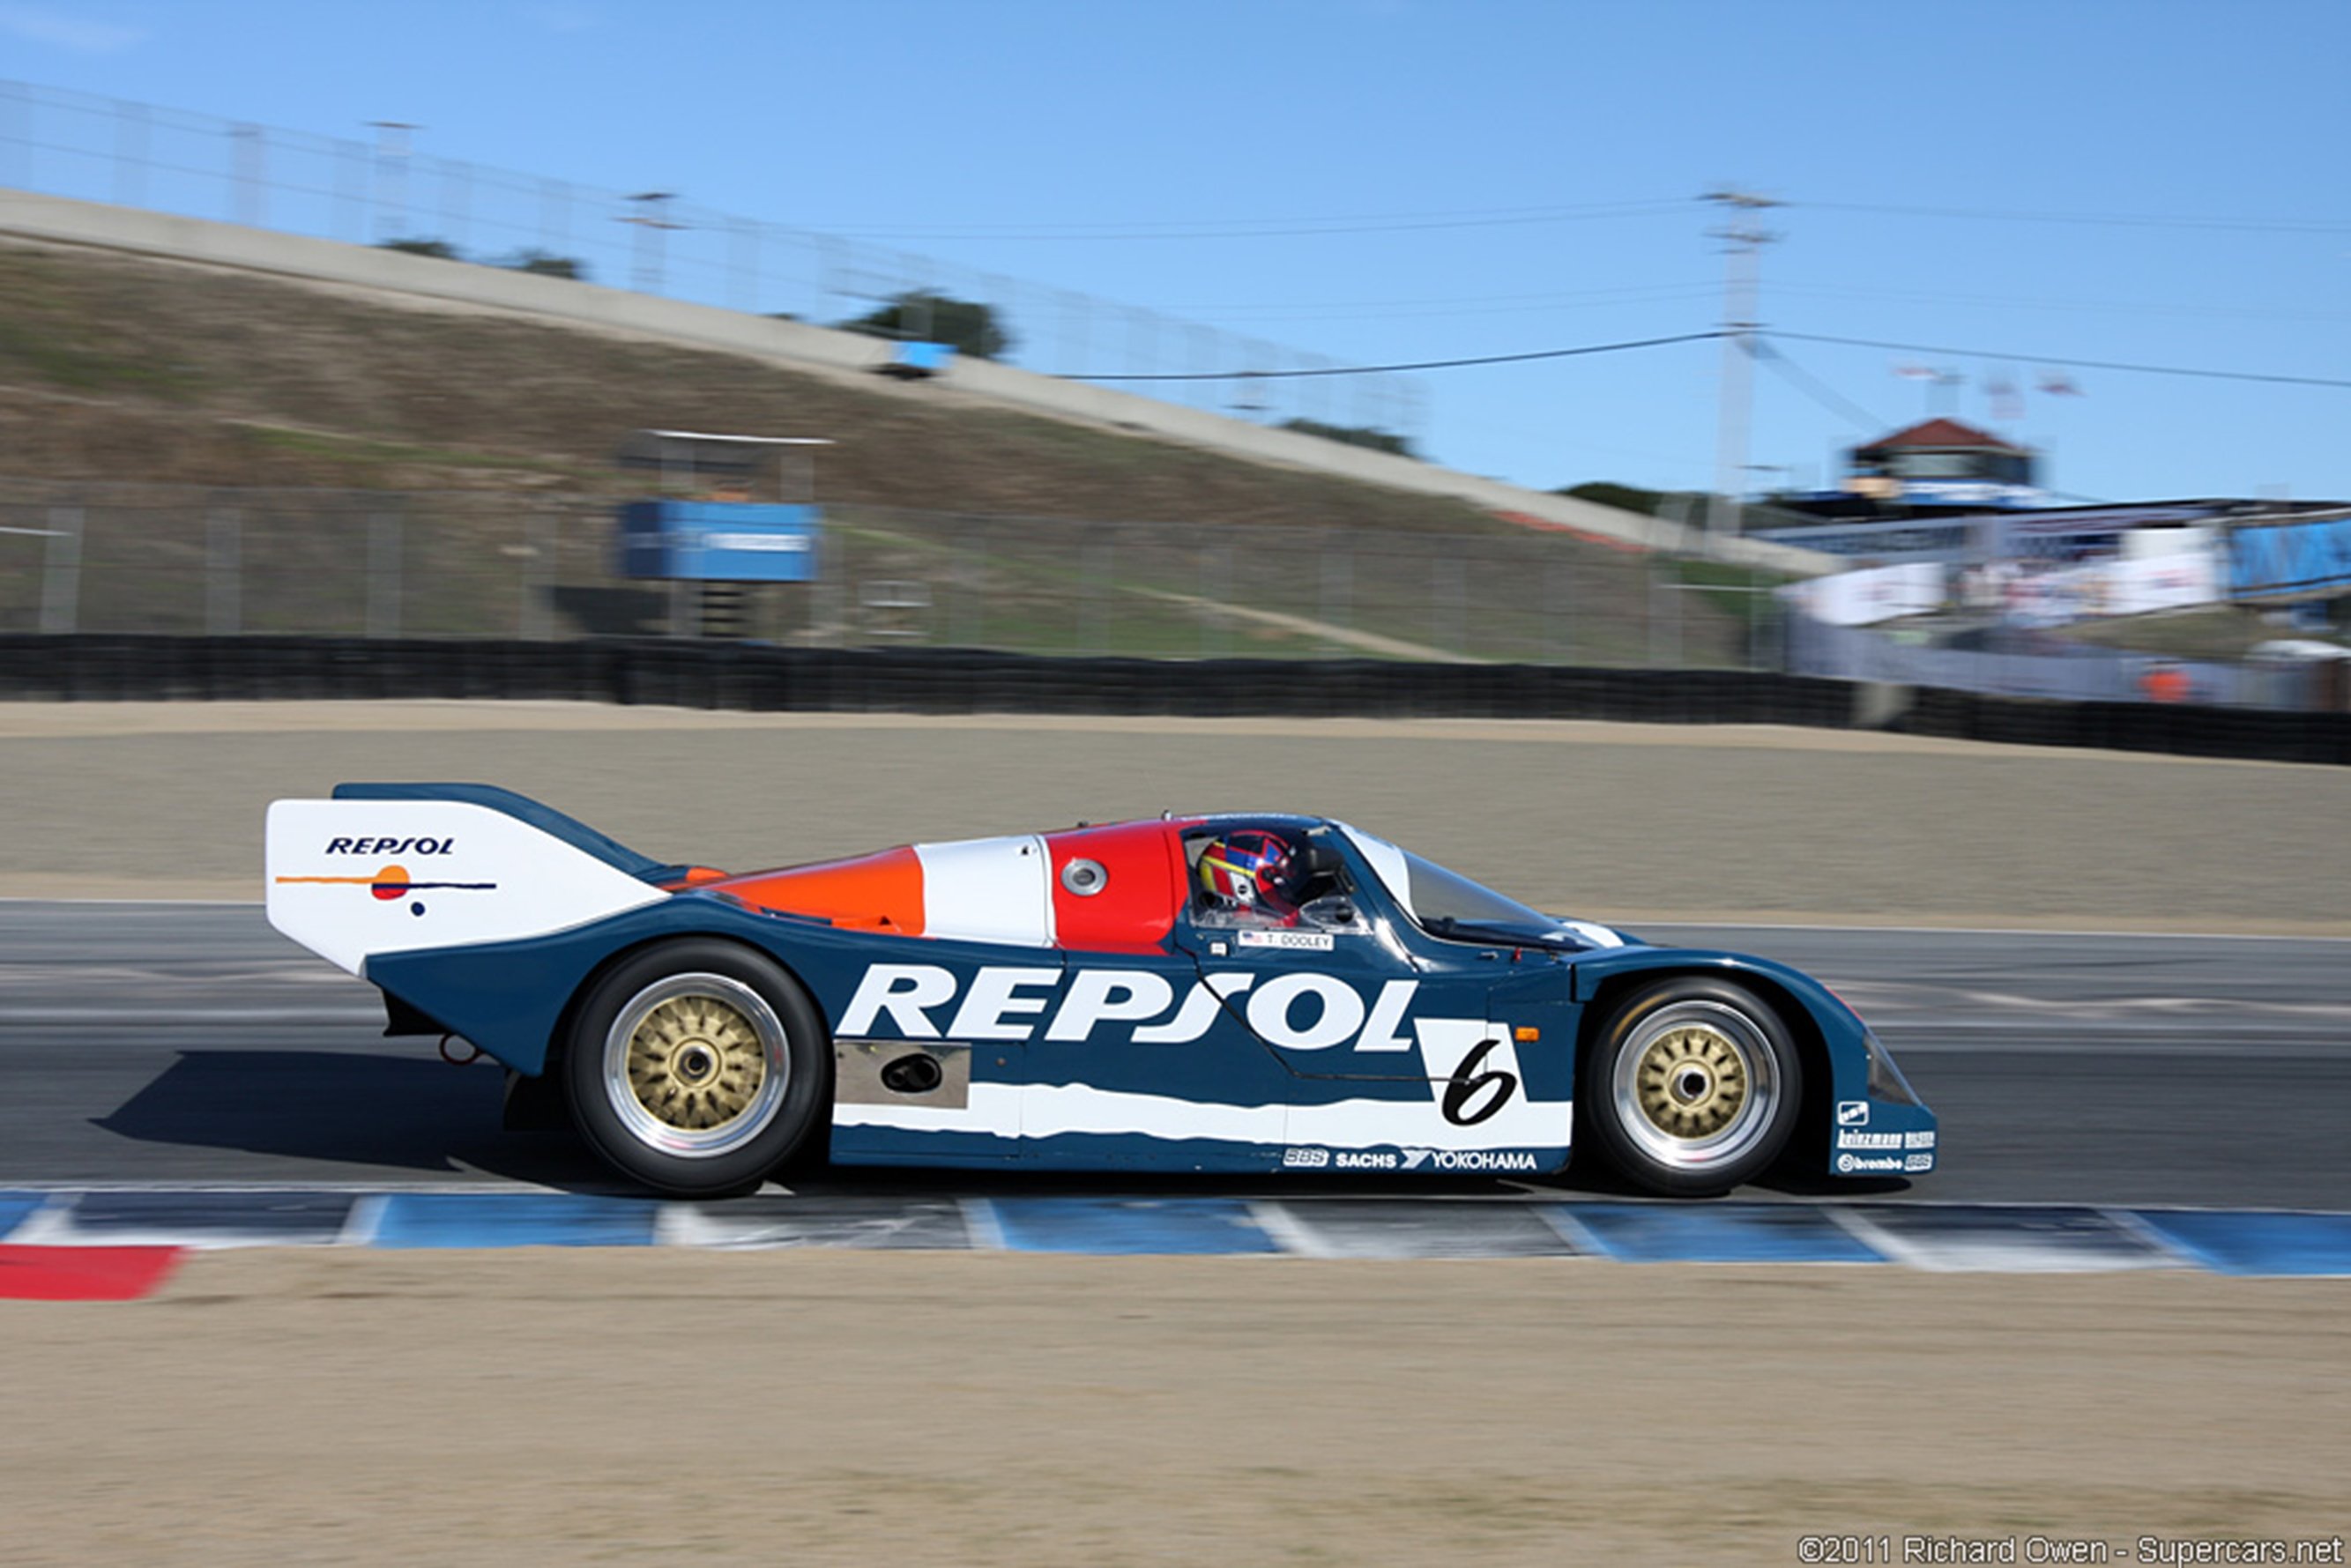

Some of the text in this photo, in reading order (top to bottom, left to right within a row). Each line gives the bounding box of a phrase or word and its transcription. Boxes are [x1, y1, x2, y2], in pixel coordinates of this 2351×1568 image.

[325, 837, 454, 855] REPSOL
[1281, 935, 1329, 947] DOOLEY
[835, 963, 1420, 1052] REPSOL
[1442, 1039, 1517, 1126] 6
[1335, 1153, 1397, 1169] SACHS
[1432, 1151, 1537, 1170] YOKOHAMA
